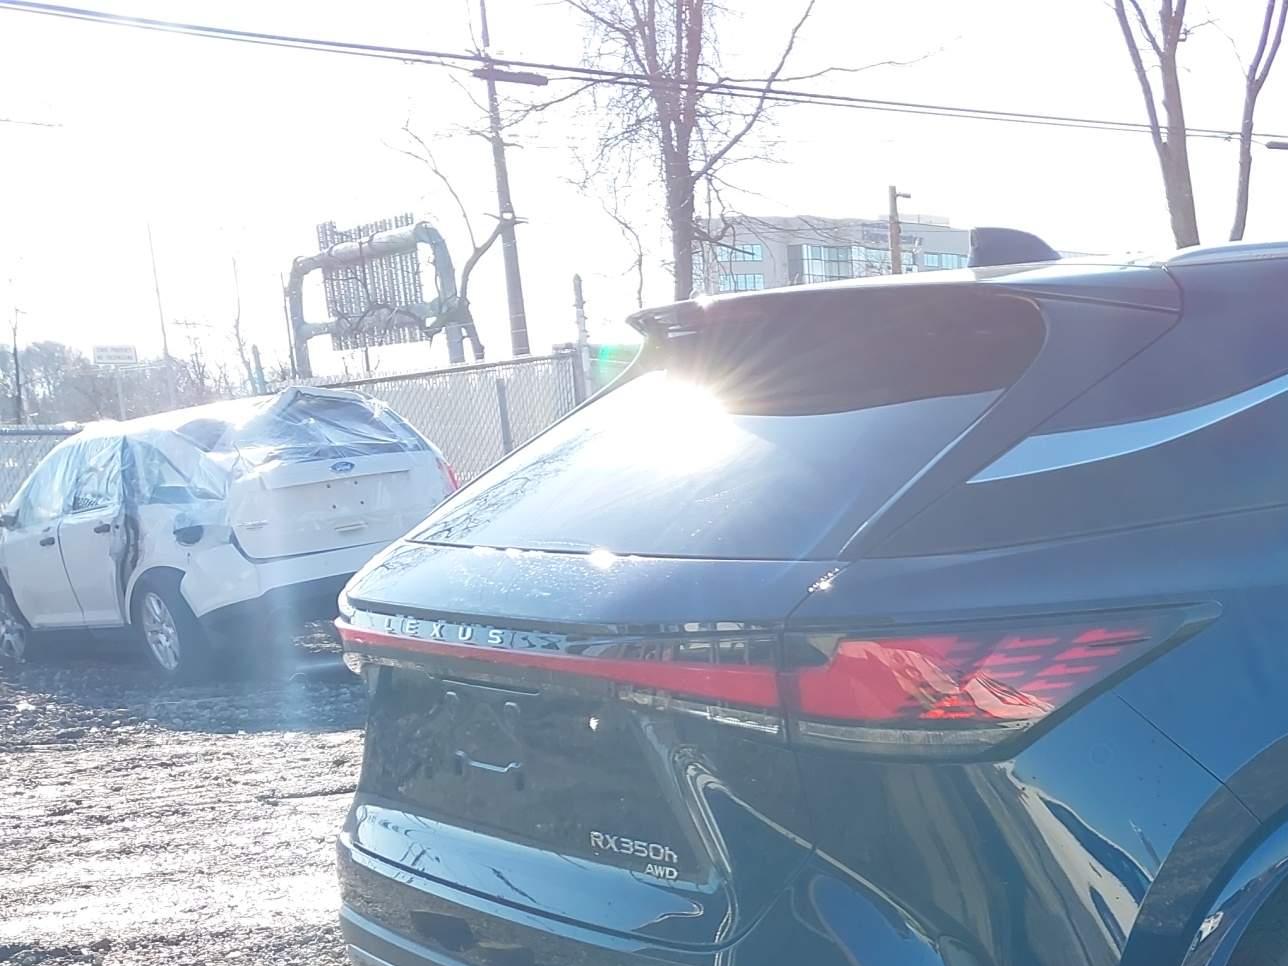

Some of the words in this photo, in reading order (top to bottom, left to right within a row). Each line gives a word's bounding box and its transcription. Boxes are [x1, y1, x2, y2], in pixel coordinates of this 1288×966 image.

[384, 617, 505, 645] LEXUS
[590, 831, 679, 863] RX350h
[645, 863, 679, 880] AWD
